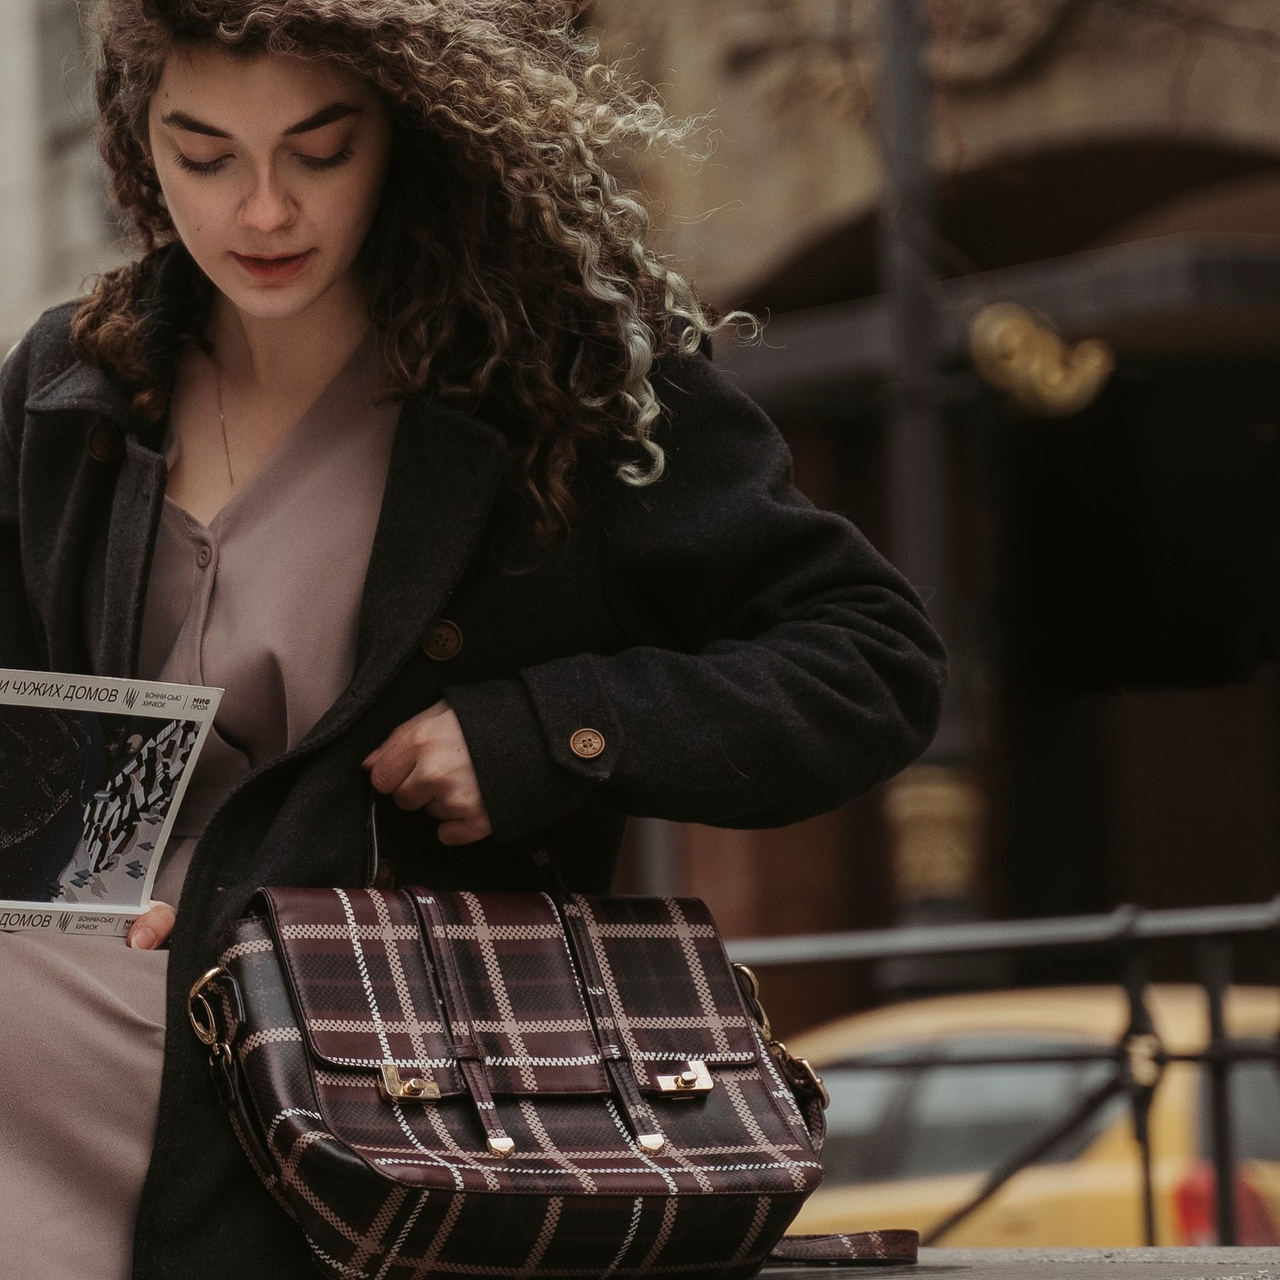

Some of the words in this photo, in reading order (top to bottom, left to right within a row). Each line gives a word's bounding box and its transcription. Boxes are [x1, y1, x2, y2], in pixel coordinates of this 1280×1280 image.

[12, 680, 64, 698] ЧУЖИХ
[63, 684, 119, 703] ДОМОВ
[145, 692, 182, 701] БОННИ-СЬЮ
[192, 697, 211, 705] МИФ
